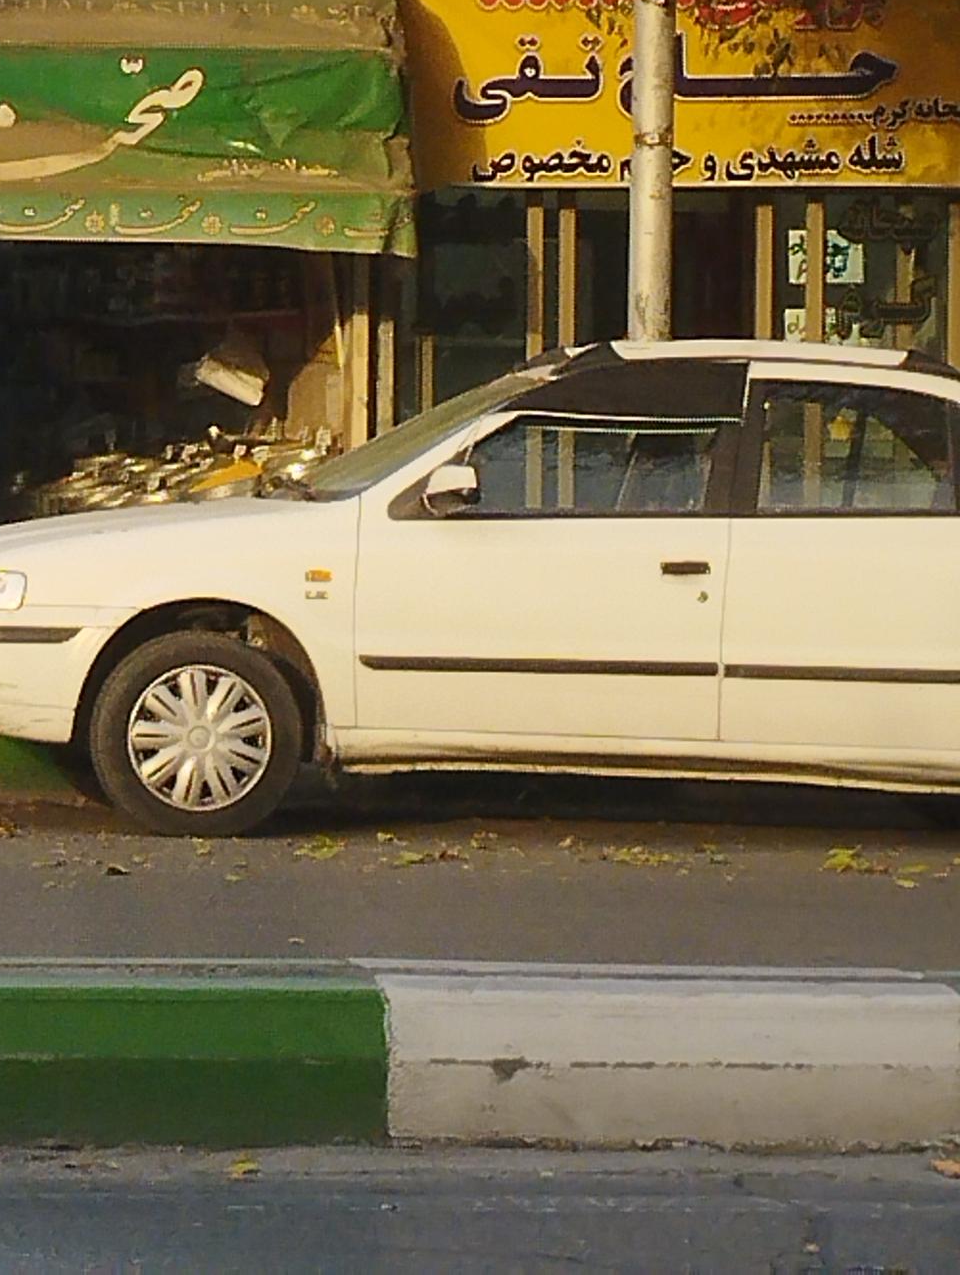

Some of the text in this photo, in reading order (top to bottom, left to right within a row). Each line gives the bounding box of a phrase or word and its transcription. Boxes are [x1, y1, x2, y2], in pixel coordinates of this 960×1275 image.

[453, 35, 602, 124] تقی
[472, 139, 613, 182] مخصوص
[701, 153, 718, 182] و
[724, 138, 841, 183] مشهدی
[848, 134, 904, 171] شله
